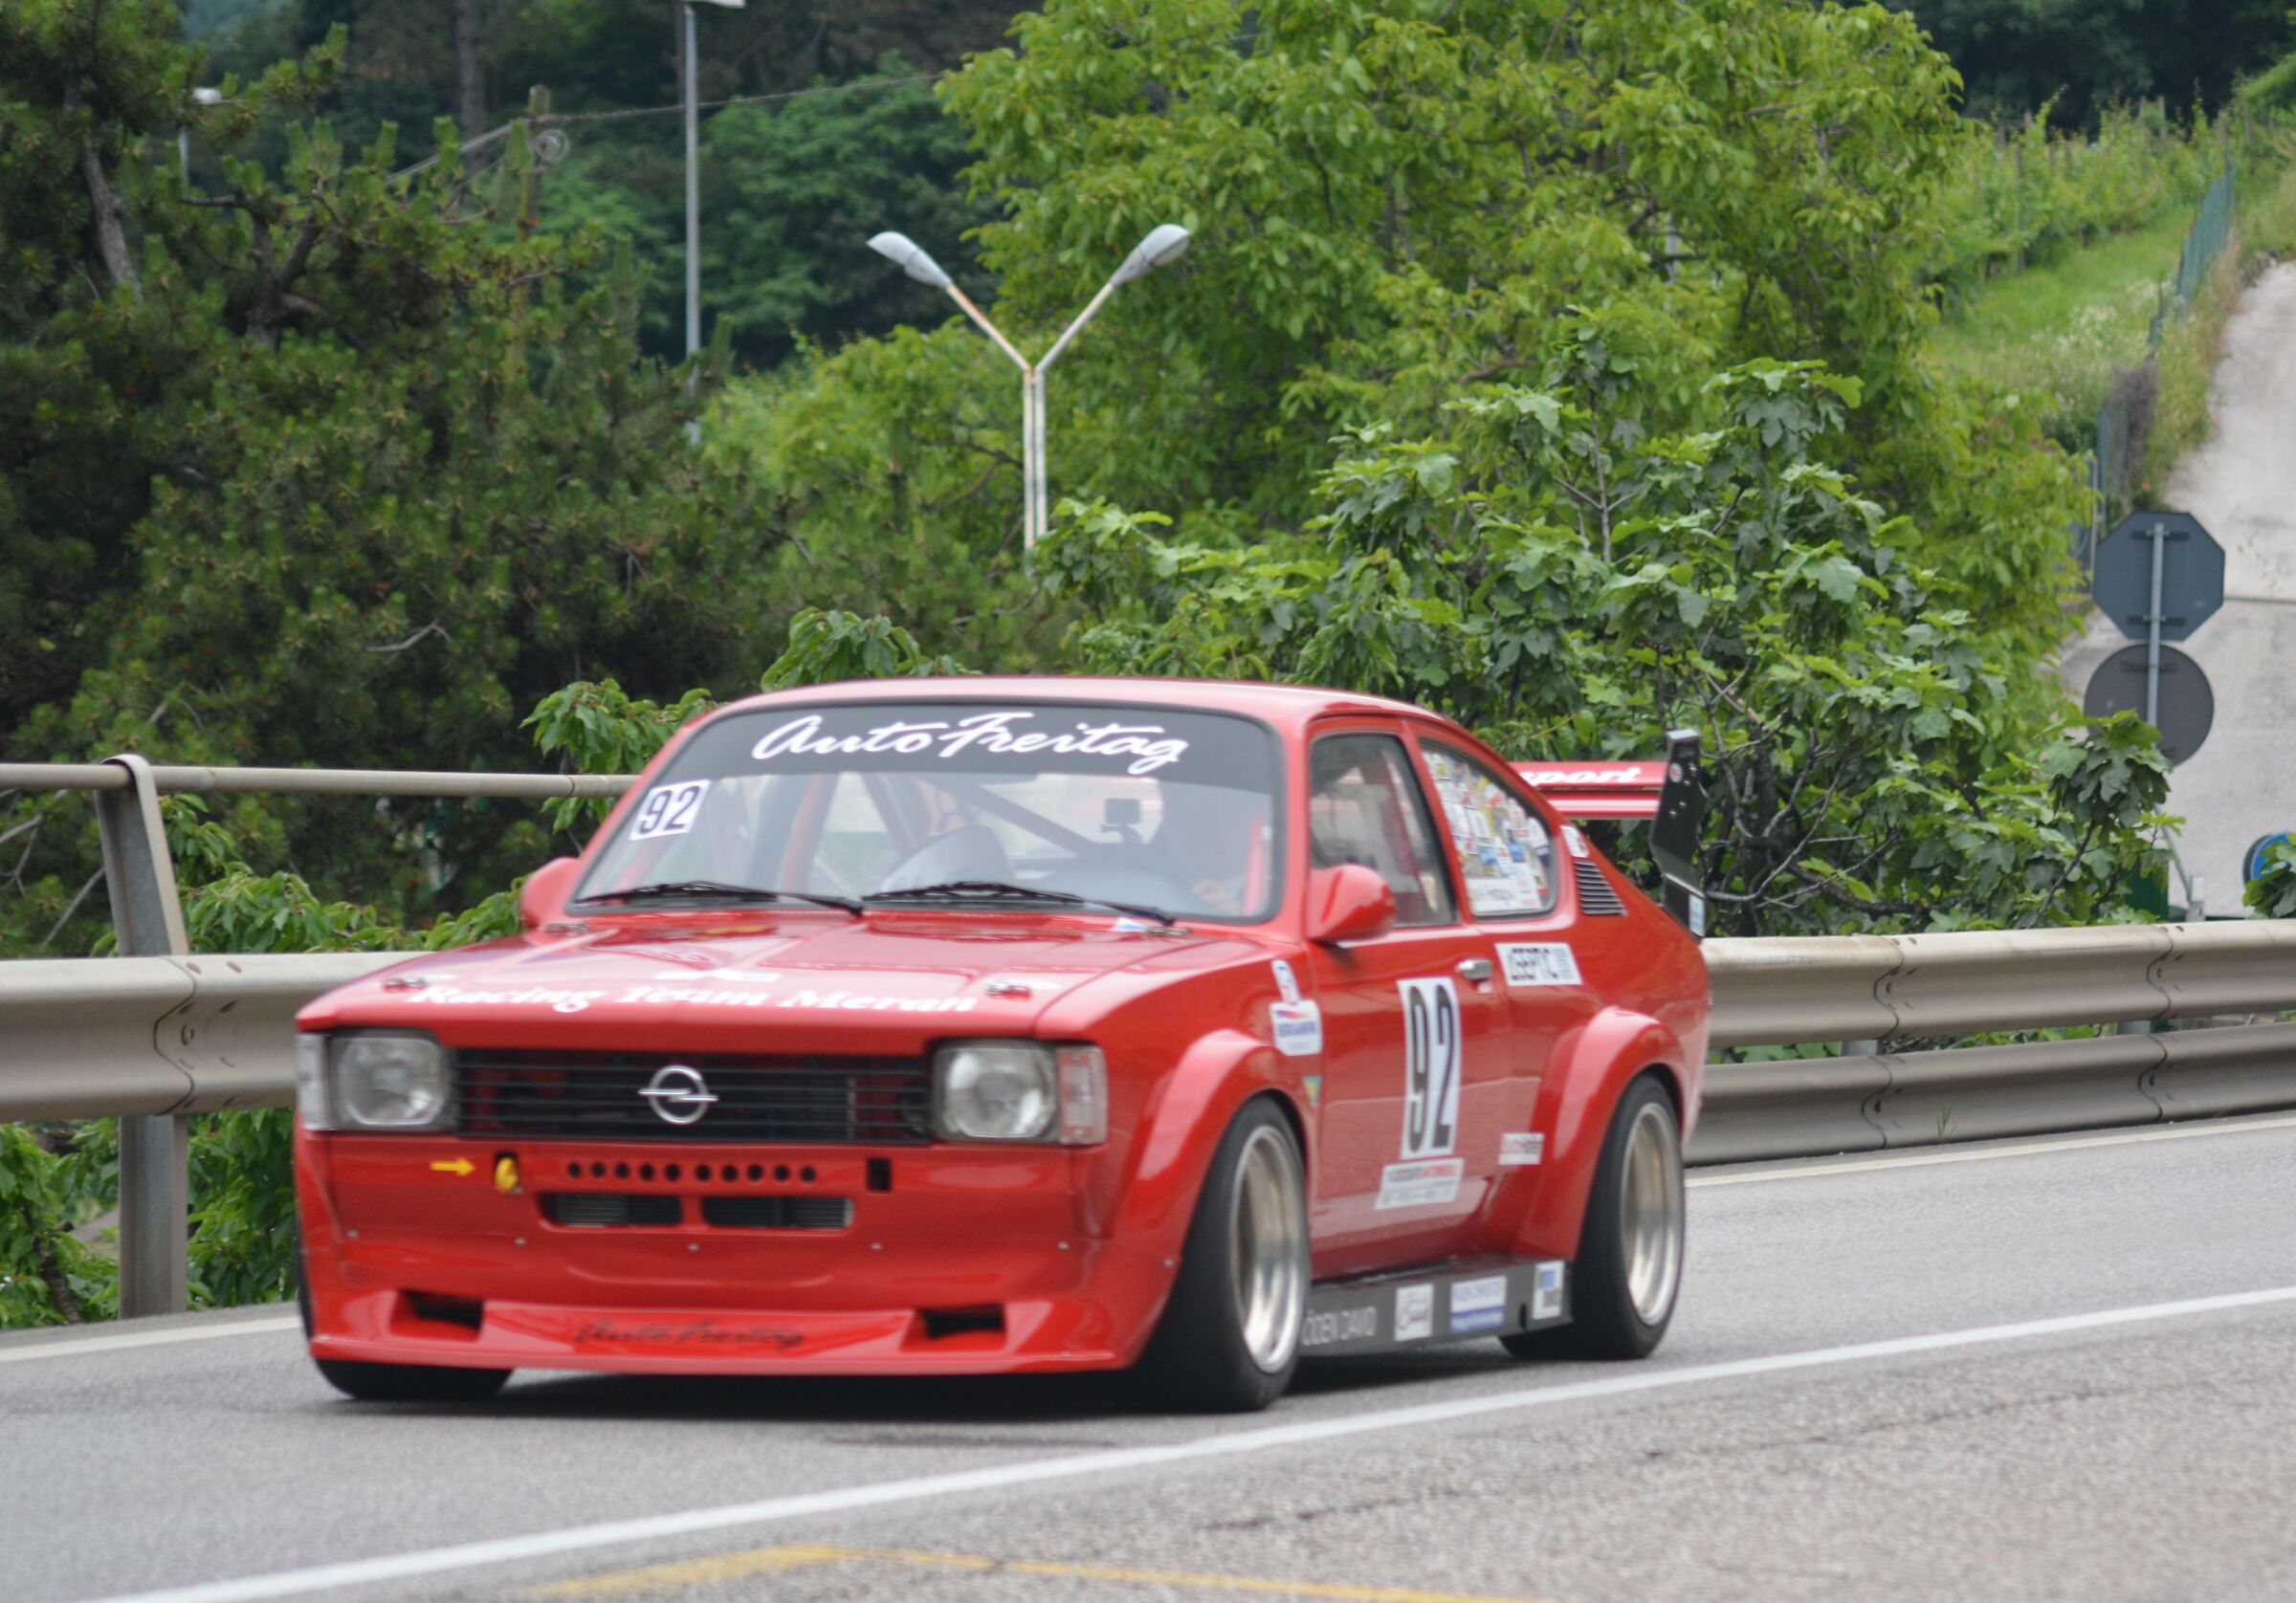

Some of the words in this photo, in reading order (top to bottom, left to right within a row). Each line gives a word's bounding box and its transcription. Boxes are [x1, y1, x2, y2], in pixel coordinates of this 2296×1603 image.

[639, 785, 700, 835] 92
[406, 986, 608, 1013] Racing
[612, 986, 769, 1007] Team
[1406, 984, 1455, 1153] 92
